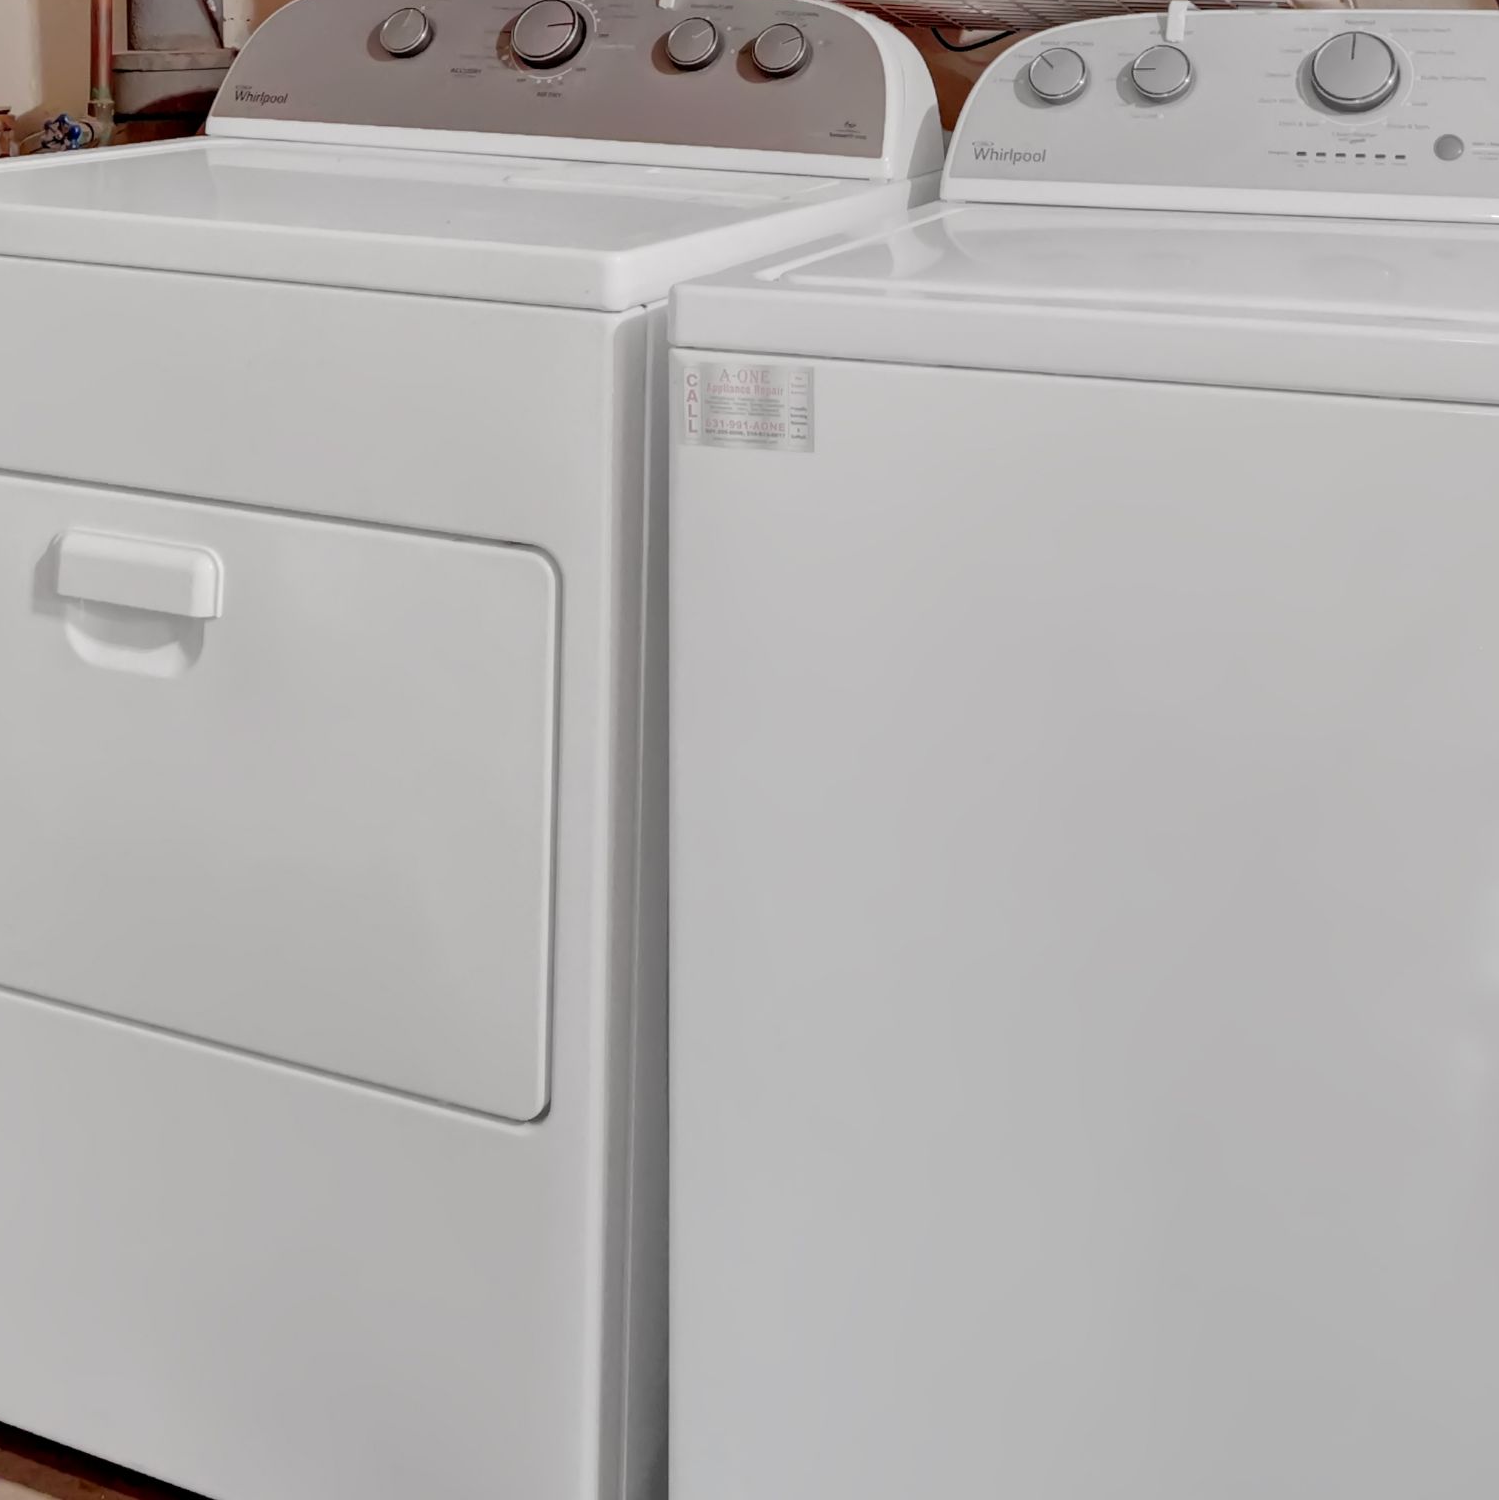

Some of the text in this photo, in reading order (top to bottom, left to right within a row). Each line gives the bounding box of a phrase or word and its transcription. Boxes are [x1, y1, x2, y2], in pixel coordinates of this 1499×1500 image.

[234, 90, 289, 107] Whirlpool
[973, 147, 1047, 166] Whirlpool
[706, 382, 751, 396] Appliance
[754, 384, 784, 397] Repair
[686, 373, 698, 434] CALL
